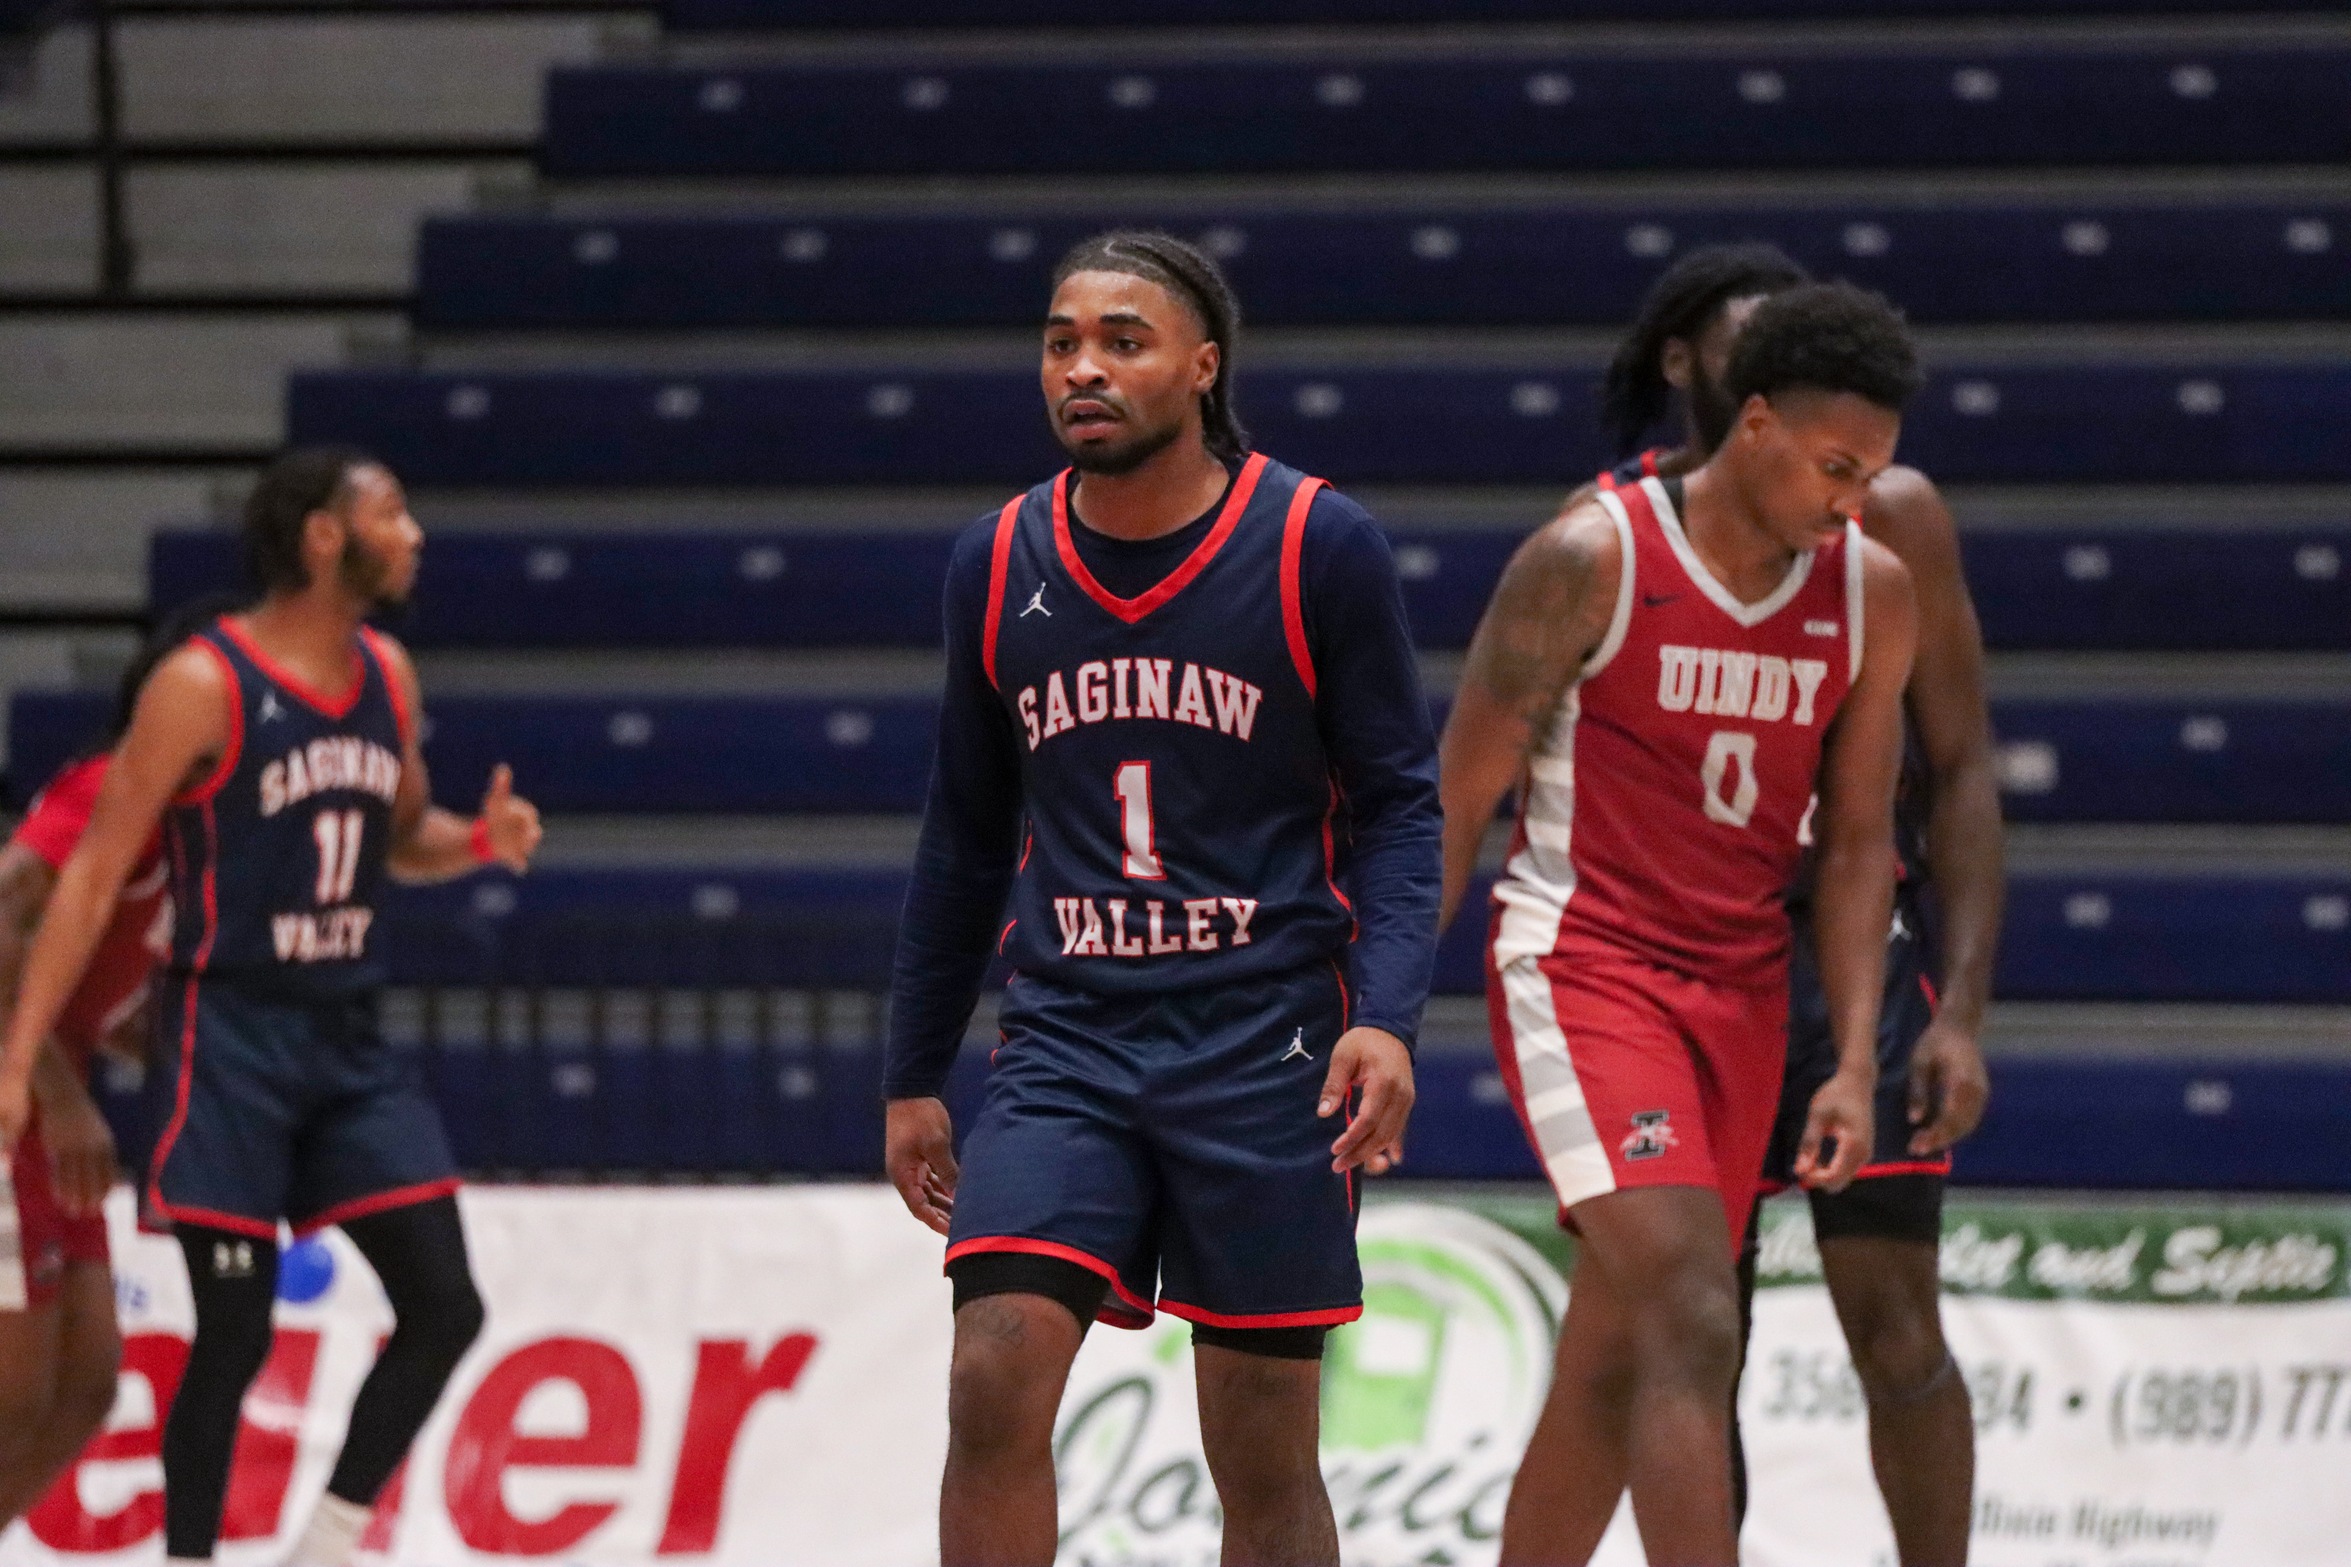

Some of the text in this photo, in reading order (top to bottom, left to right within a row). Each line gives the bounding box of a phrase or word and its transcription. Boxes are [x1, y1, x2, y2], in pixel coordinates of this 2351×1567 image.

[1017, 657, 1263, 751] SAGINAW
[1657, 644, 1827, 726] UINDY
[1113, 760, 1167, 881] 1
[1700, 730, 1758, 828] 0
[313, 808, 364, 904] 11
[1053, 897, 1260, 957] VALLEY
